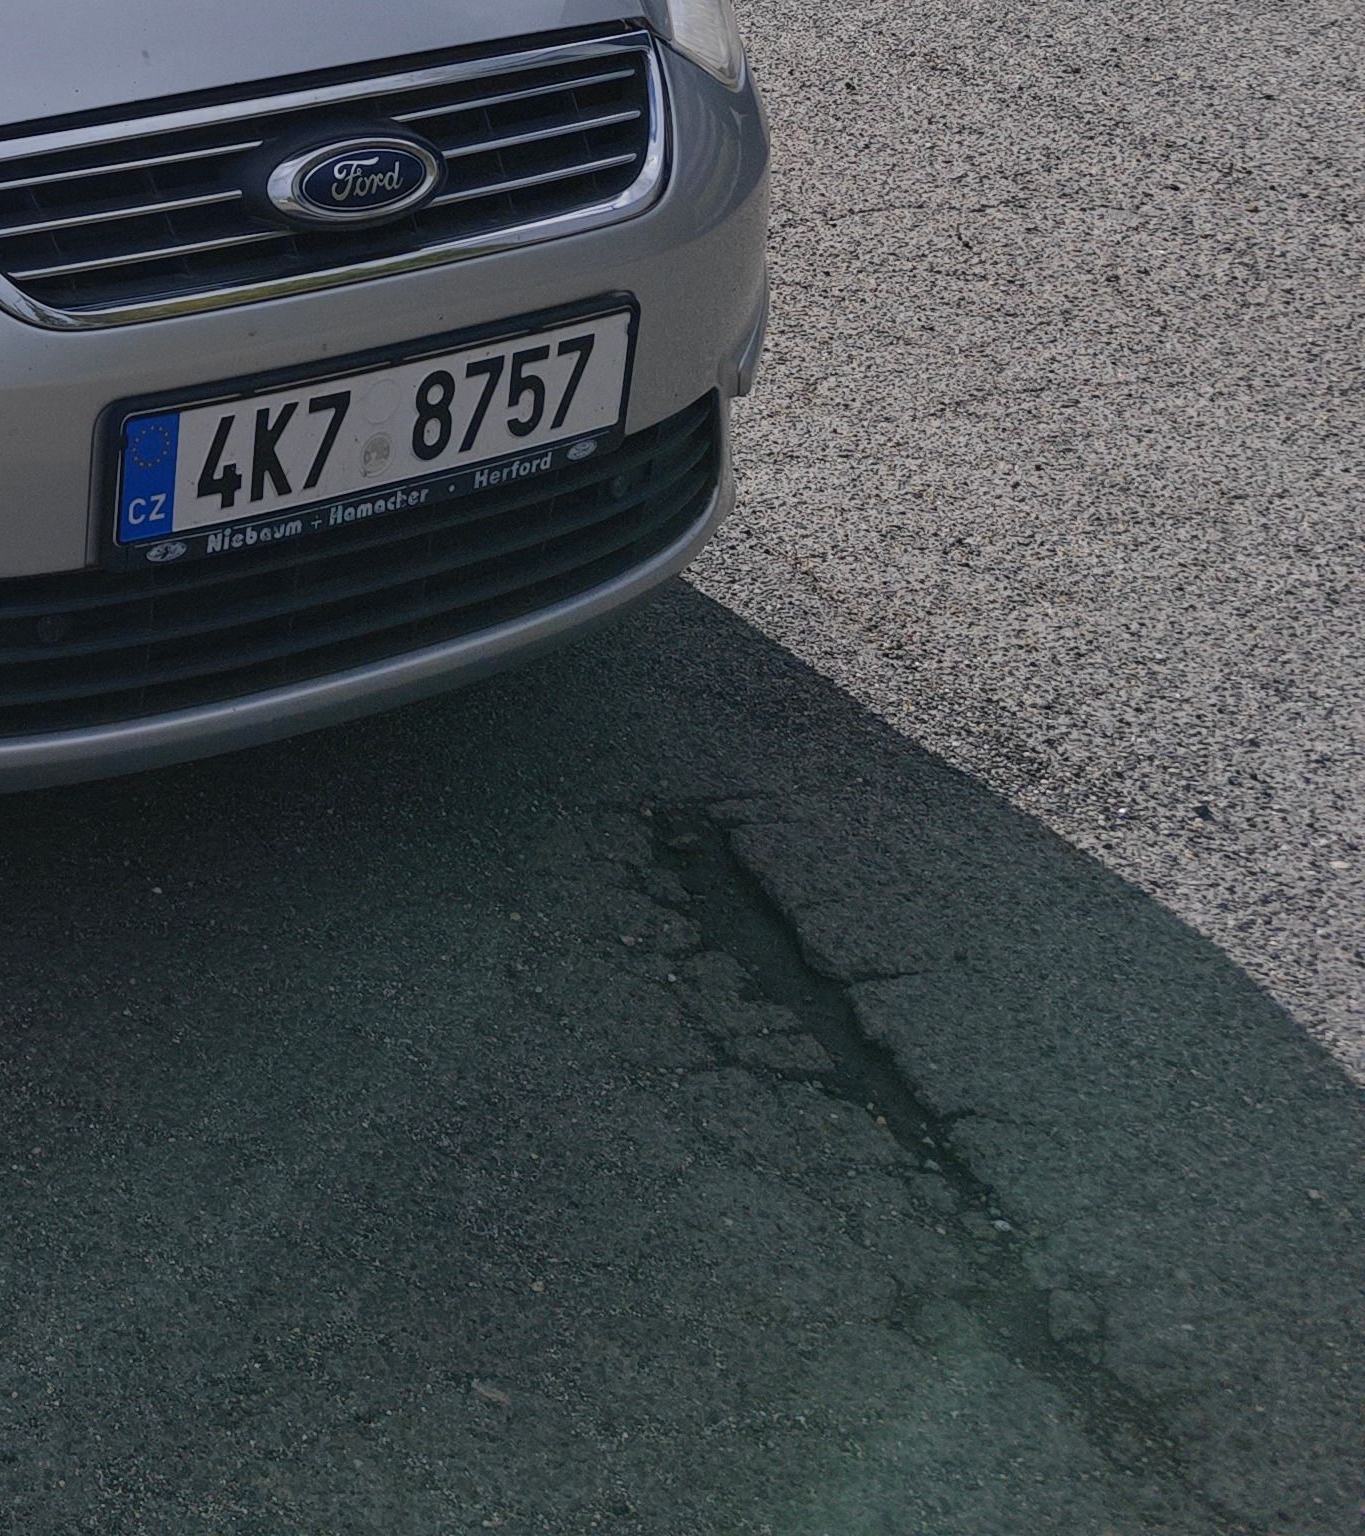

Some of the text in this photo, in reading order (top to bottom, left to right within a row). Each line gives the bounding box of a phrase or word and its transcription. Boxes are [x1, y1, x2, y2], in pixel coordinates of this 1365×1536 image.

[331, 155, 403, 201] Ford
[196, 333, 596, 510] 4K7 8757
[473, 451, 553, 490] Herford
[127, 493, 167, 526] CZ
